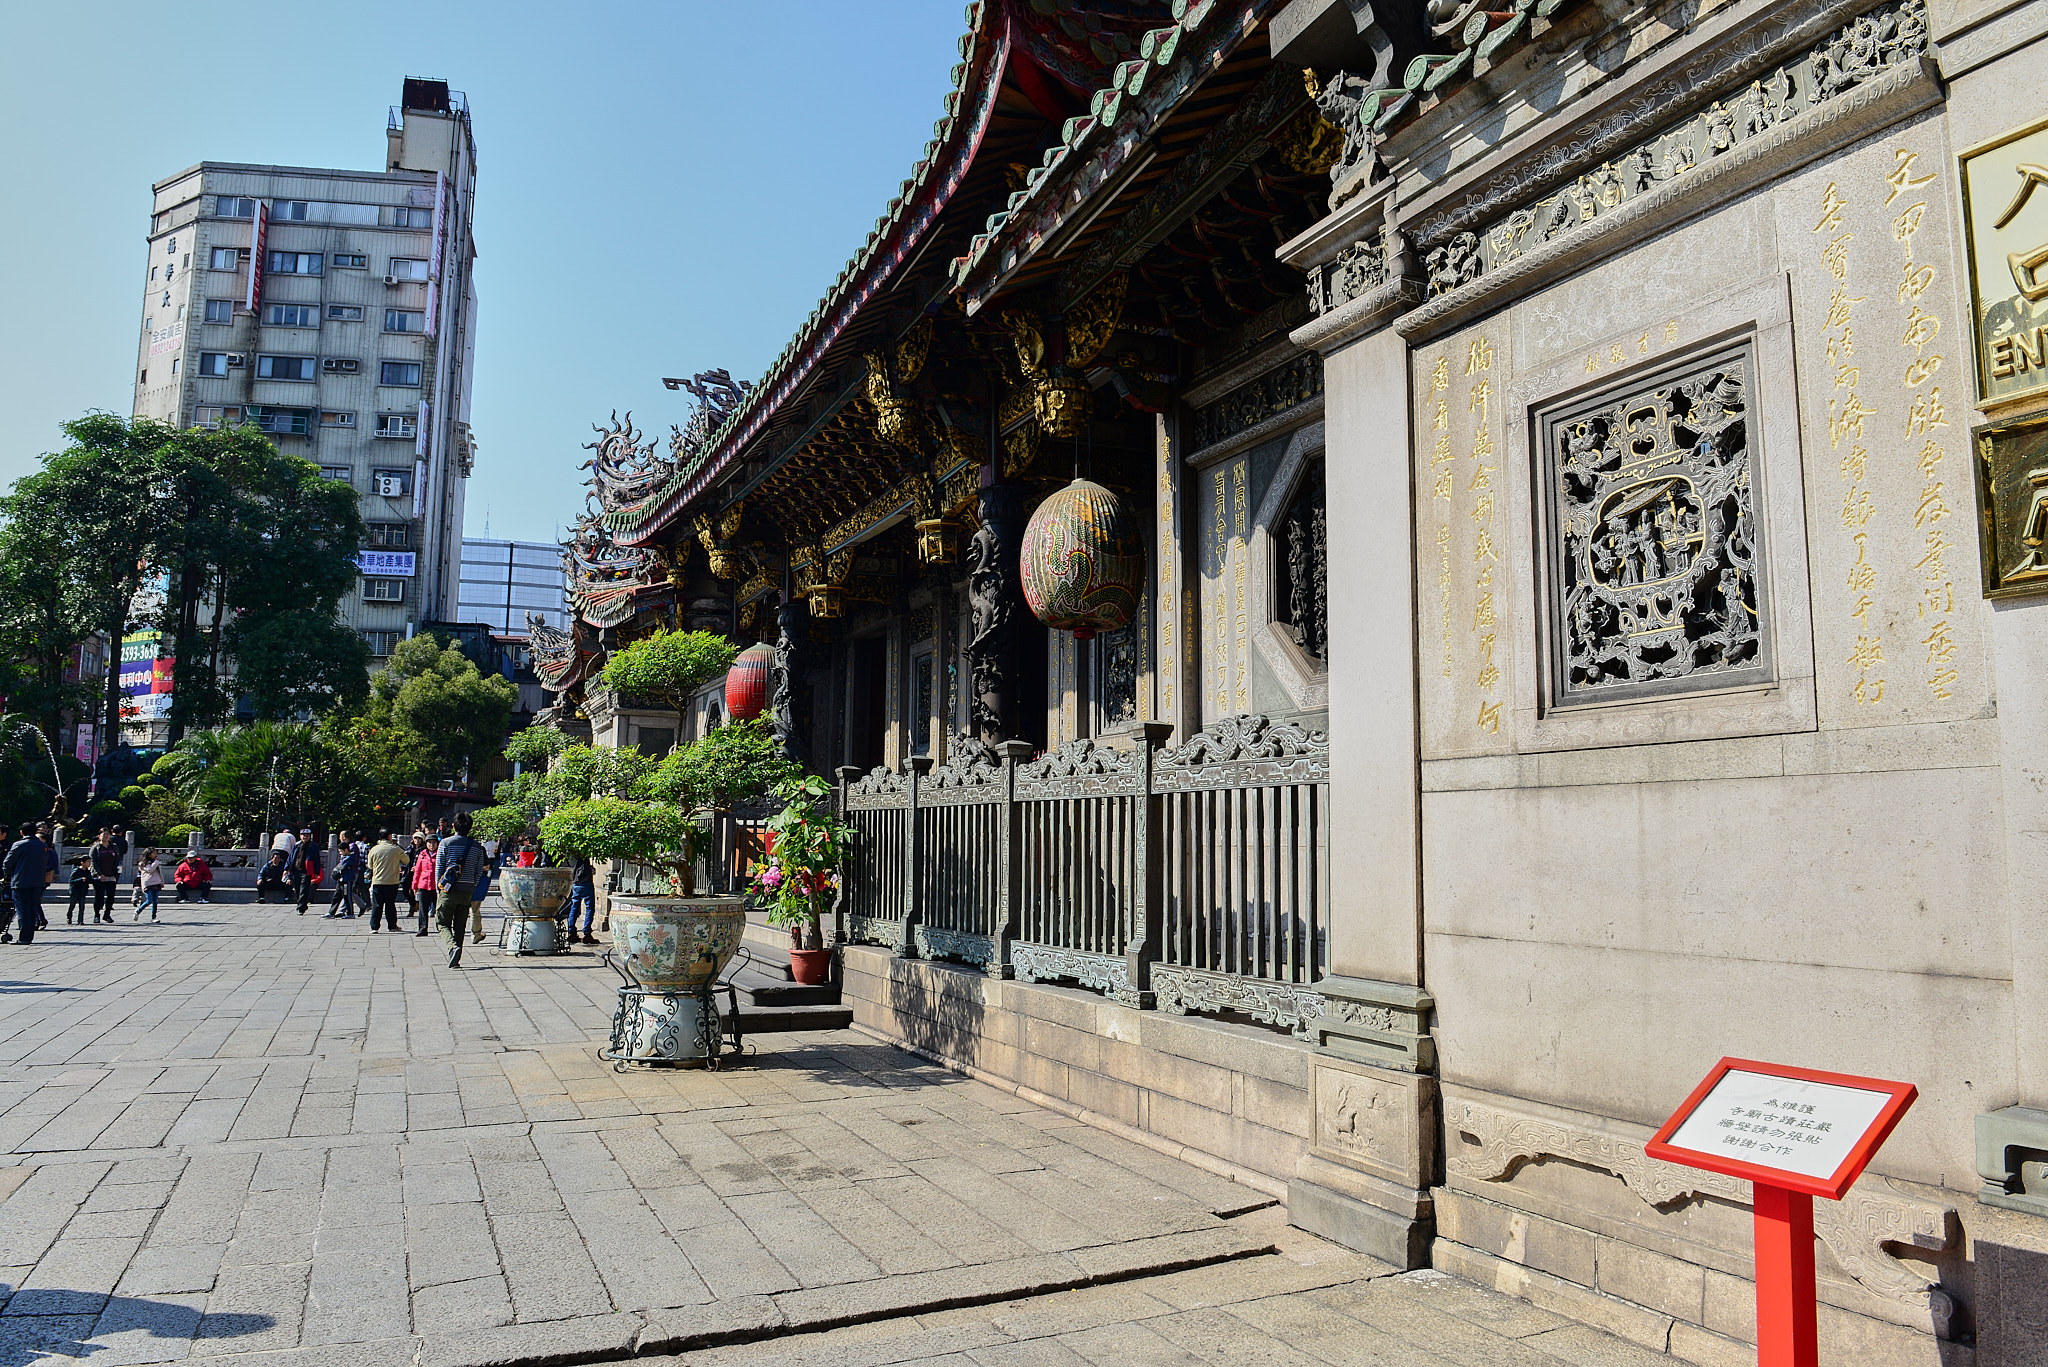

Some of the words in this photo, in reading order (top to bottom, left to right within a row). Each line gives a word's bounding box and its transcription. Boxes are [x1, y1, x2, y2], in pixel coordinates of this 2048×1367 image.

[1762, 1098, 1816, 1114] 為維護
[1716, 1118, 1823, 1145] 牆壁請勿張貼
[1730, 1106, 1833, 1133] 寺廟古蹟莊嚴
[1722, 1134, 1794, 1156] 謝謝合作
